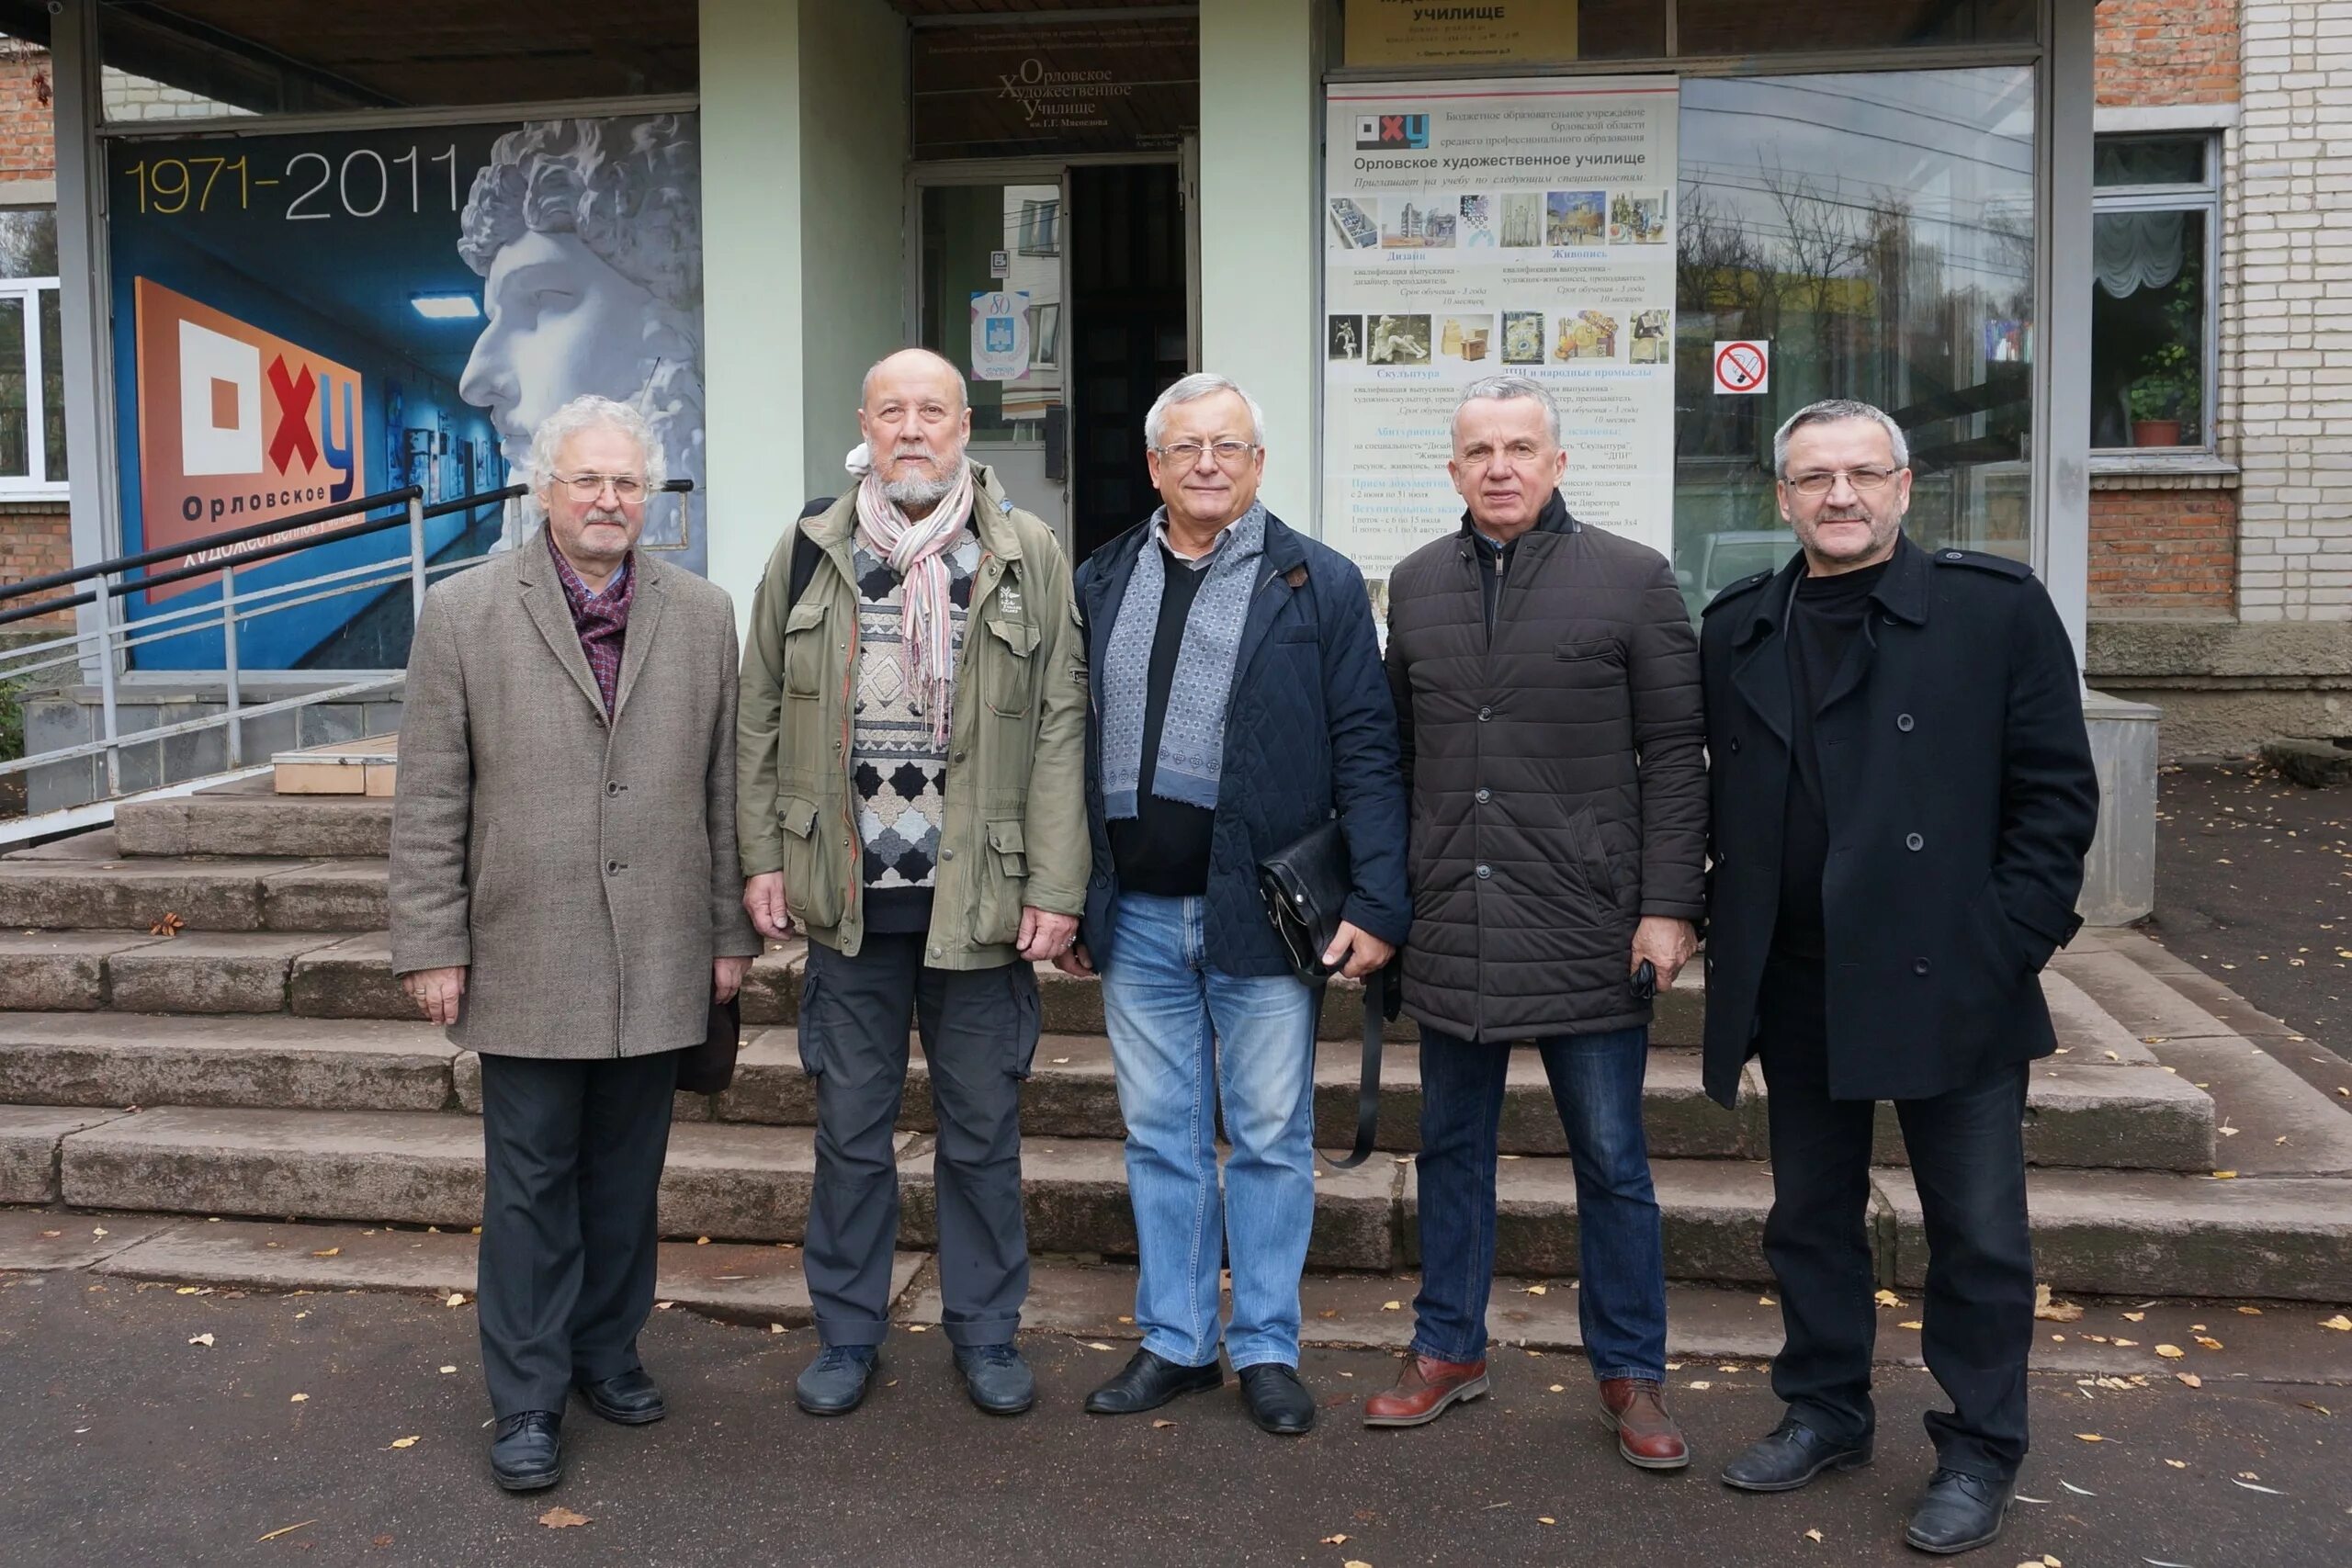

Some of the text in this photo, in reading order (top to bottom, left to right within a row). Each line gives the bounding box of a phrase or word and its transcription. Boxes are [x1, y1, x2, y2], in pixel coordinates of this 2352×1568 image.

[1413, 6, 1505, 21] УЧИЛИЩЕ
[1020, 58, 1113, 88] Орловское
[998, 73, 1133, 101] Художественное
[1023, 98, 1096, 120] Училище
[1445, 107, 1645, 121] Бюджетное образовательное учреждение
[1551, 119, 1645, 132] Орловской области
[1440, 132, 1645, 148] среднего профессионального образования
[1353, 152, 1646, 173] Орловское художественное училище
[125, 143, 458, 220] 1971-2011
[1425, 179, 1437, 187] на
[1475, 177, 1487, 186] по
[1493, 175, 1553, 186] следующим
[1387, 251, 1426, 262] Дизайн
[1553, 249, 1608, 260] Живопись
[1400, 288, 1421, 297] Срок
[1423, 287, 1455, 295] обучения
[1557, 286, 1577, 294] Срок
[1578, 285, 1613, 293] обучения
[989, 293, 1011, 315] 80
[1376, 368, 1441, 379] Скульптура
[1540, 369, 1591, 379] народные
[1594, 368, 1652, 378] промыслы
[182, 485, 325, 524] Орловское
